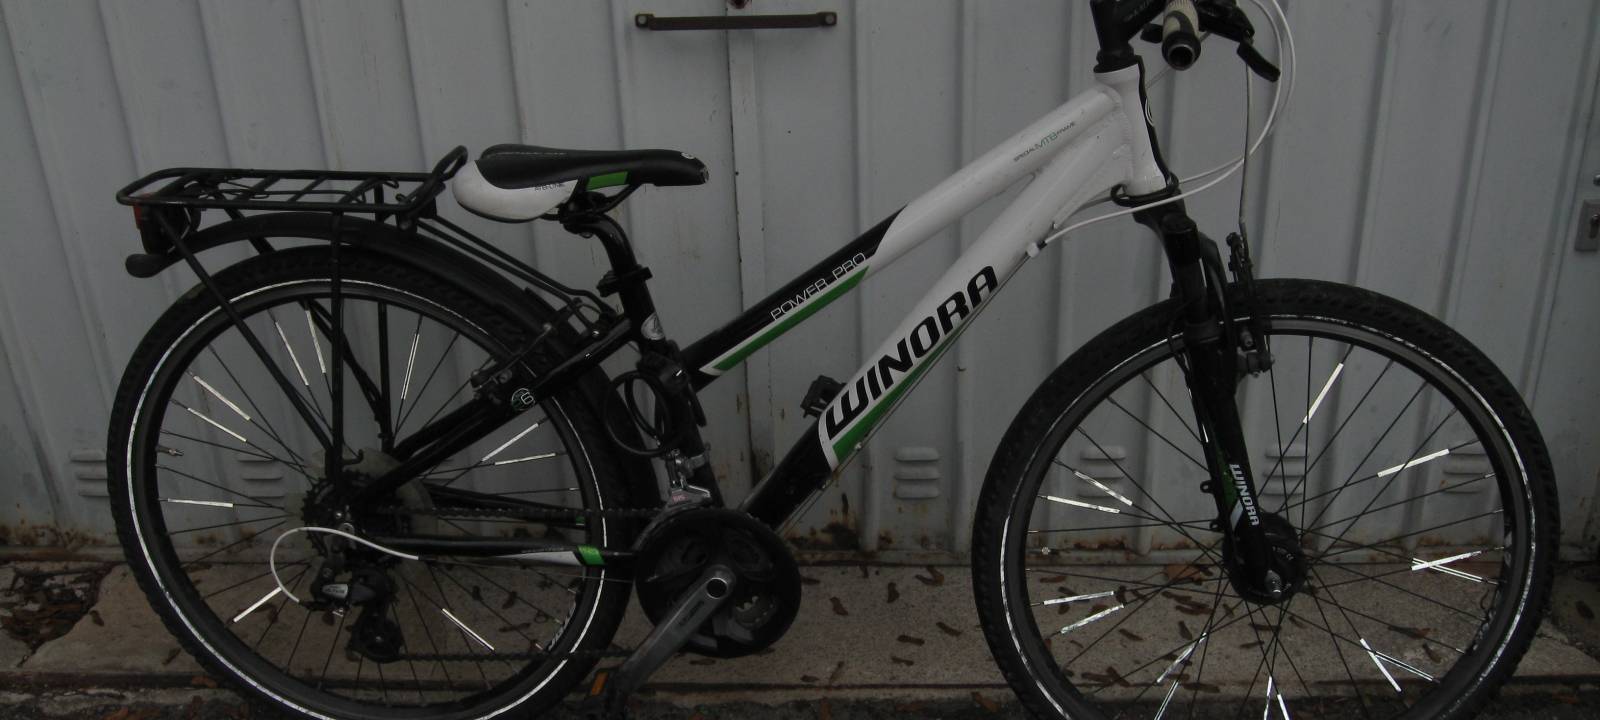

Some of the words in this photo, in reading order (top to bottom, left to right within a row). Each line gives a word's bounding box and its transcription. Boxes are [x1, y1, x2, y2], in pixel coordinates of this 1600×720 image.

[770, 278, 827, 320] POWER
[832, 252, 866, 279] PRO
[826, 265, 998, 440] WINORA
[1229, 464, 1259, 526] WINORA
